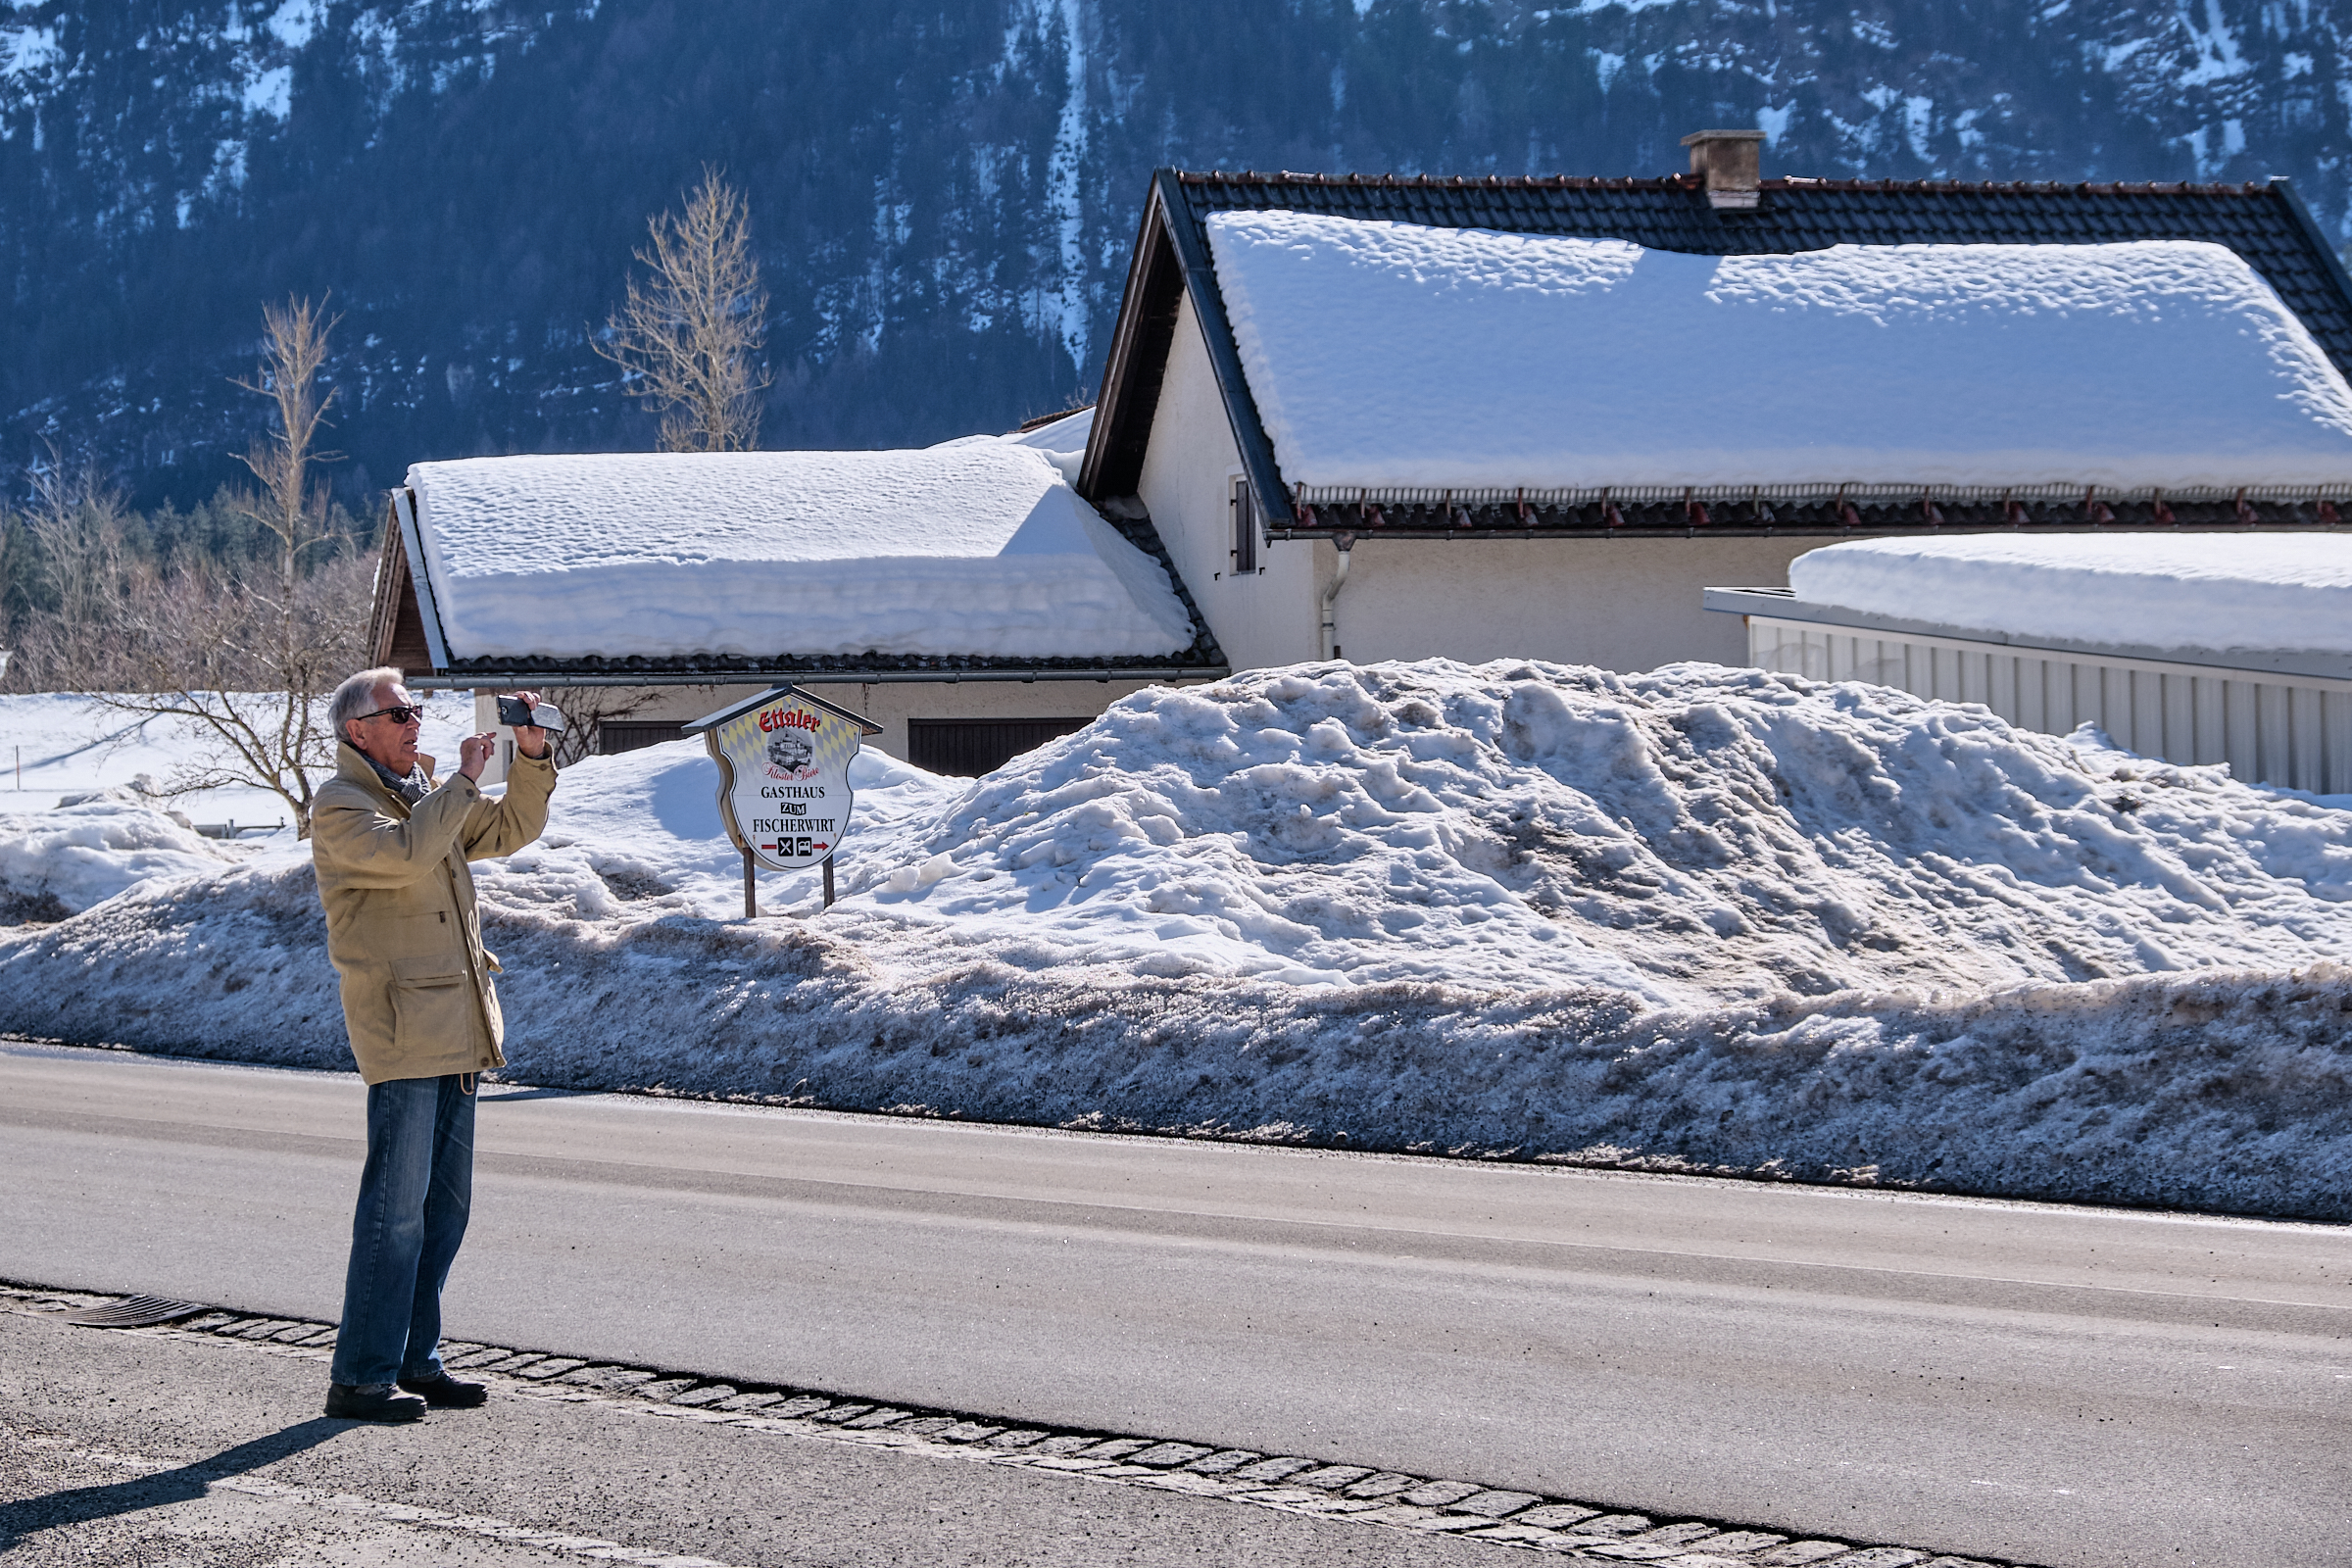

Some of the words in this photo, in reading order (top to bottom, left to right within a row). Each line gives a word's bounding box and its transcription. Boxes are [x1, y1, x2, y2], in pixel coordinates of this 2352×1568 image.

[760, 708, 820, 732] Ettaler
[760, 786, 825, 799] GASTHAUS
[782, 803, 805, 814] ZUM
[753, 818, 835, 832] FISCHERWIRT
